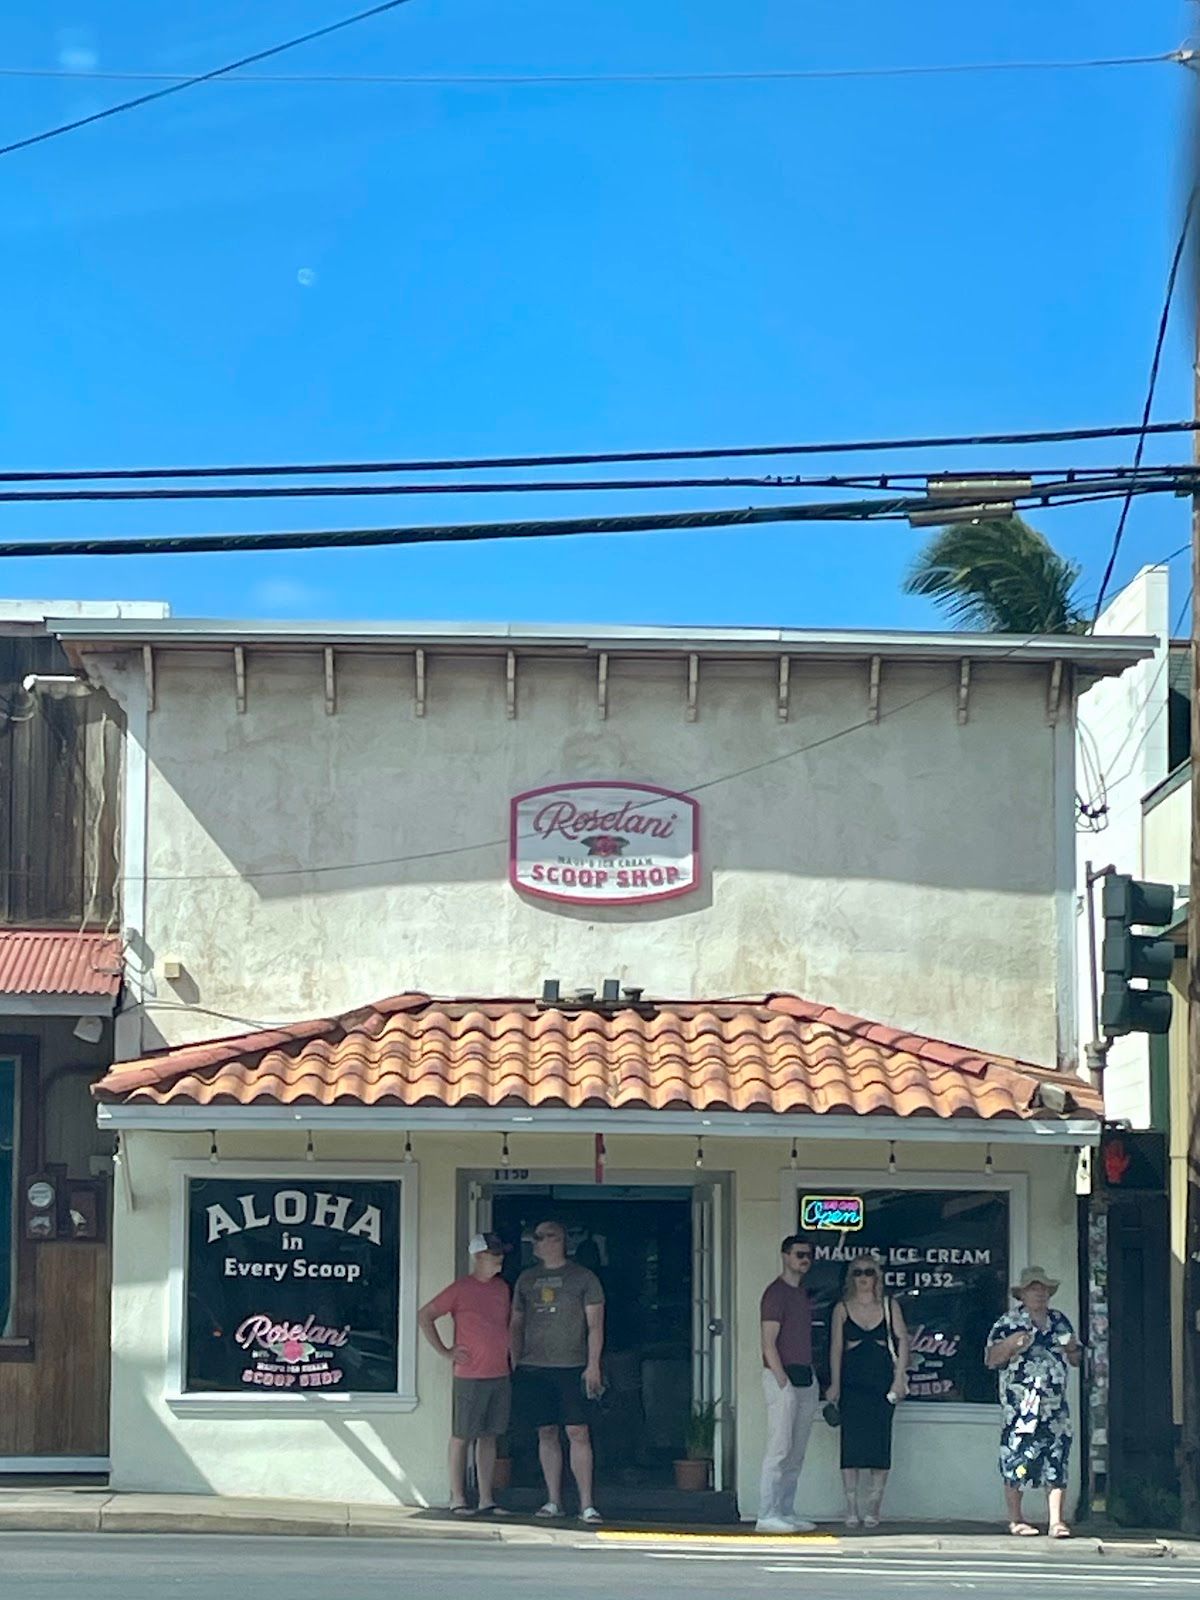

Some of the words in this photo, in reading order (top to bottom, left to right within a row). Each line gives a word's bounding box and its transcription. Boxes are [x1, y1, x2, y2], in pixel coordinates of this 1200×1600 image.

[533, 800, 678, 840] Roselani
[531, 864, 608, 888] SCOOP
[616, 866, 679, 888] SHOP
[206, 1190, 382, 1246] ALOHA
[805, 1200, 861, 1229] Open
[281, 1231, 303, 1250] in
[888, 1247, 919, 1262] ICE
[926, 1249, 991, 1264] CREAM
[224, 1257, 289, 1281] Every
[293, 1258, 361, 1282] Scoop
[914, 1271, 954, 1287] 1932
[235, 1313, 351, 1349] Roselani
[242, 1368, 296, 1387] SCOOP
[299, 1368, 343, 1387] SHOP
